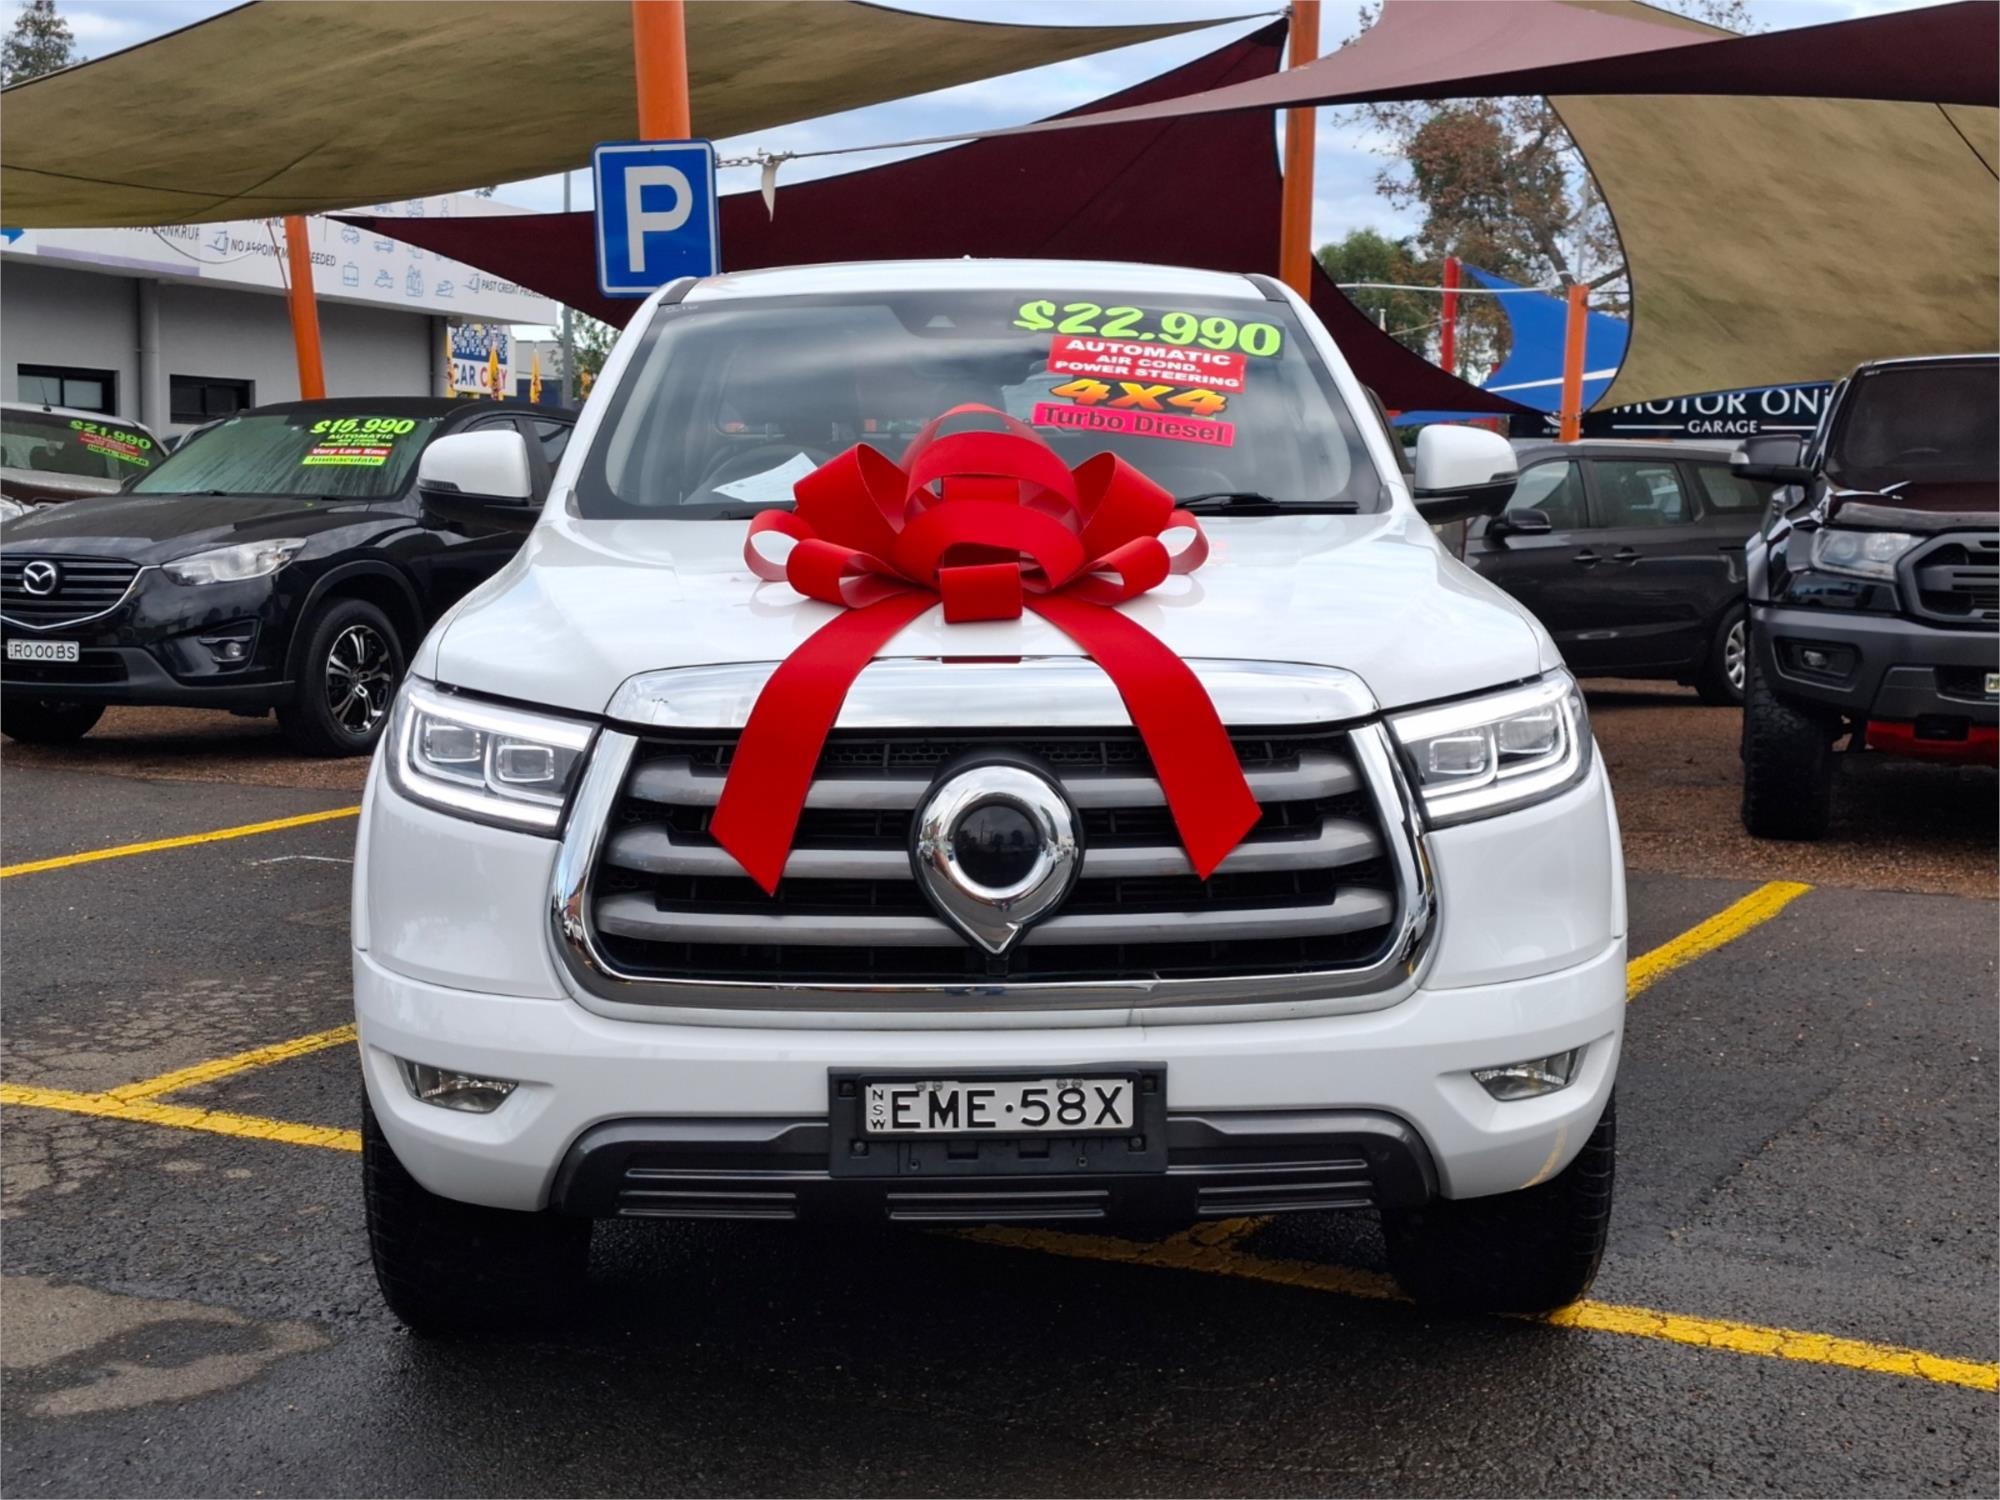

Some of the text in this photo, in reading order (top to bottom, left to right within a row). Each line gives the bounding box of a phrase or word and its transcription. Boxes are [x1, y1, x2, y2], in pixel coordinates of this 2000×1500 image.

[624, 165, 693, 272] P
[229, 239, 337, 267] NO APPOINTM EEDED
[1065, 339, 1231, 365] AUTOMATIC
[1096, 354, 1202, 373] AIR COND.
[480, 366, 508, 390] CY
[1055, 360, 1240, 387] POWER STEERING
[1612, 393, 1747, 414] OOR
[1043, 407, 1225, 442] Turbo Diesel
[1687, 420, 1758, 433] GARAGE
